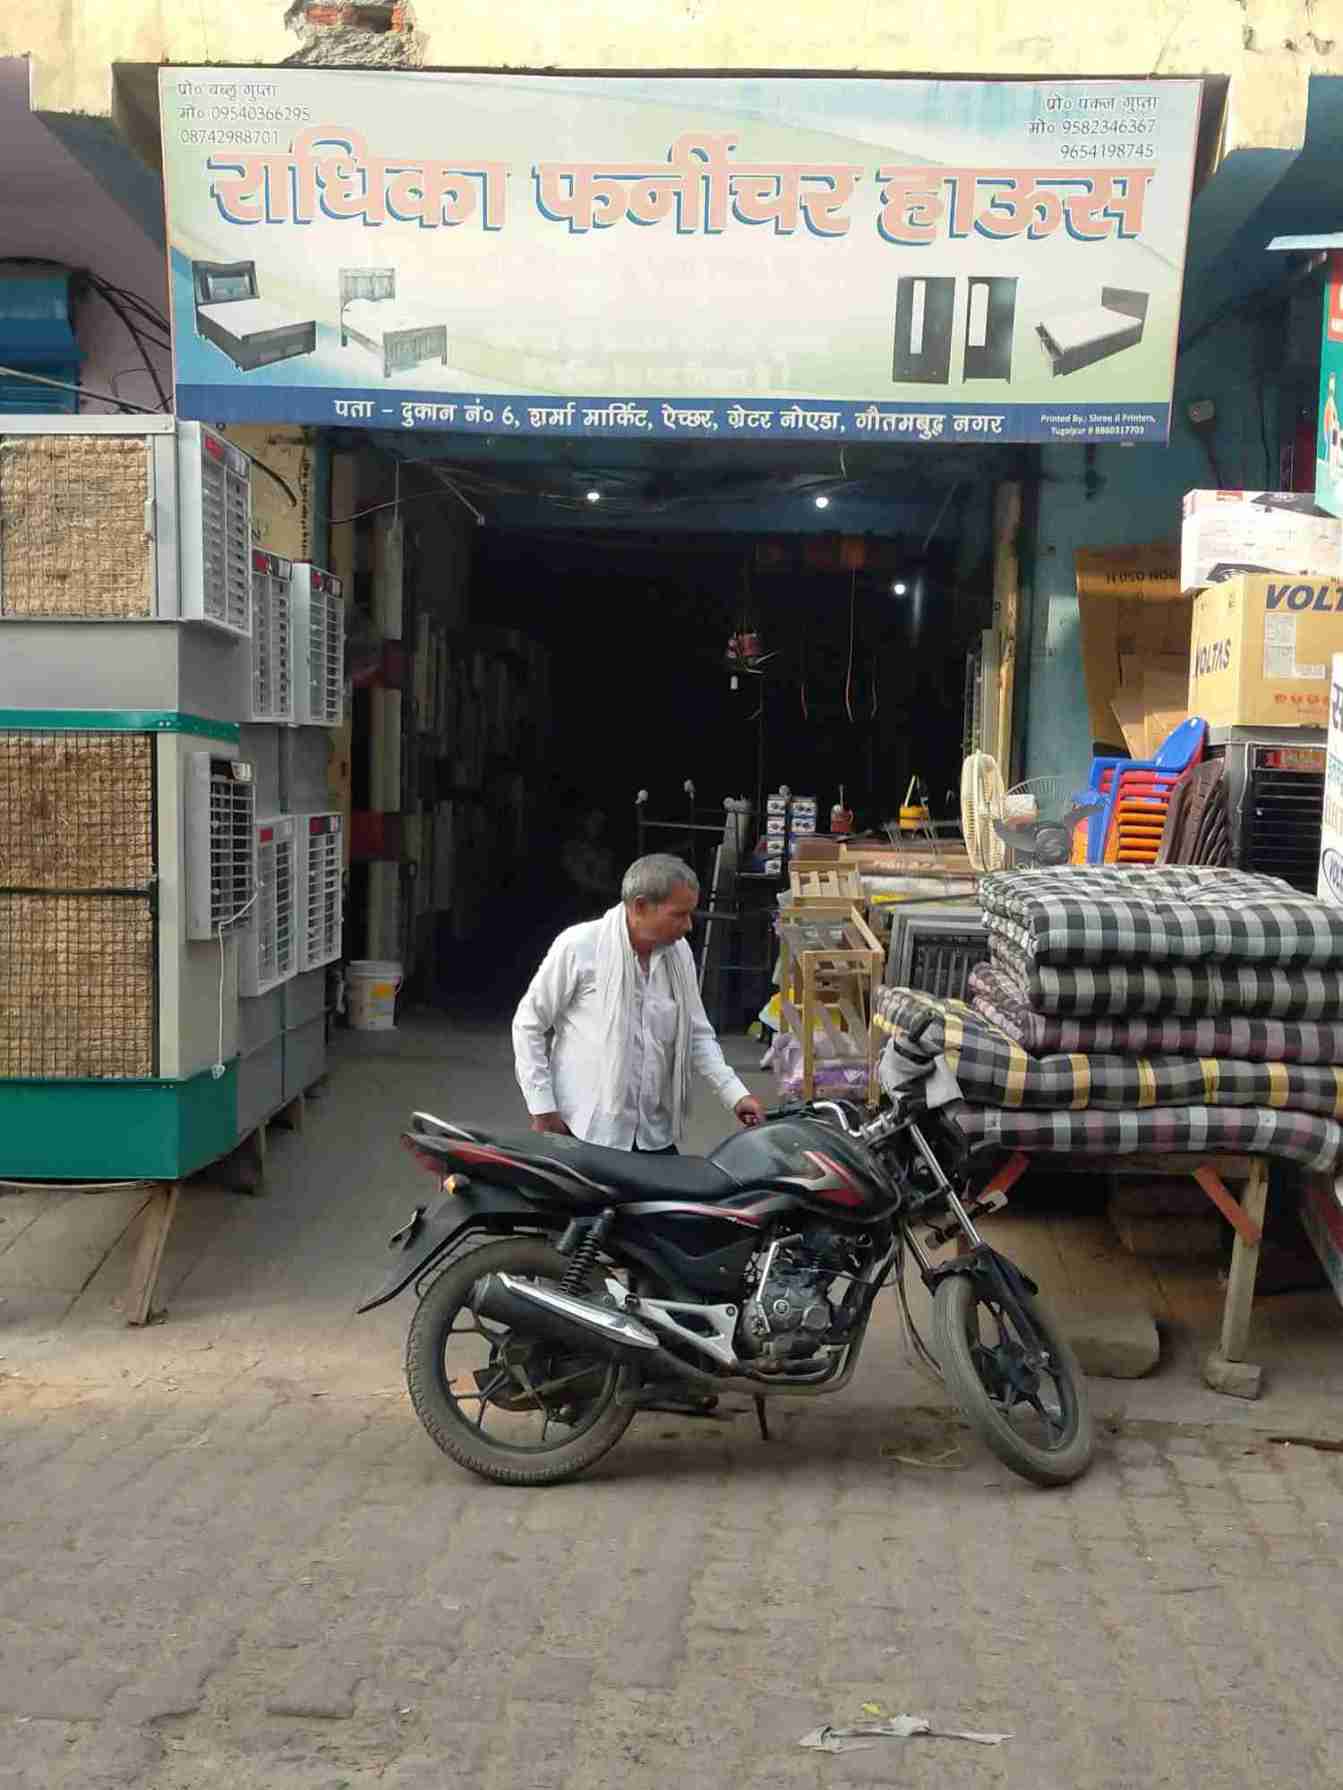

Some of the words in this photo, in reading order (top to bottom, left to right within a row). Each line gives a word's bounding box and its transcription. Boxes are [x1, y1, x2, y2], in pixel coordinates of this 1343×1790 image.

[1062, 119, 1156, 135] 9582346367
[180, 128, 280, 144] 08742988701
[1060, 143, 1154, 159] 9654198745
[206, 124, 512, 231] राधिका
[531, 129, 864, 238] फर्नीचर
[875, 164, 1155, 246] हाऊस
[334, 399, 374, 418] पता
[401, 401, 457, 427] दुकान
[502, 405, 520, 428] 6,
[528, 401, 576, 427] शर्मा
[727, 406, 773, 430] ग्रेटर
[780, 405, 846, 433] नोएडा,
[855, 405, 945, 439] गौतमबुद्ध
[953, 414, 1004, 433] नगर
